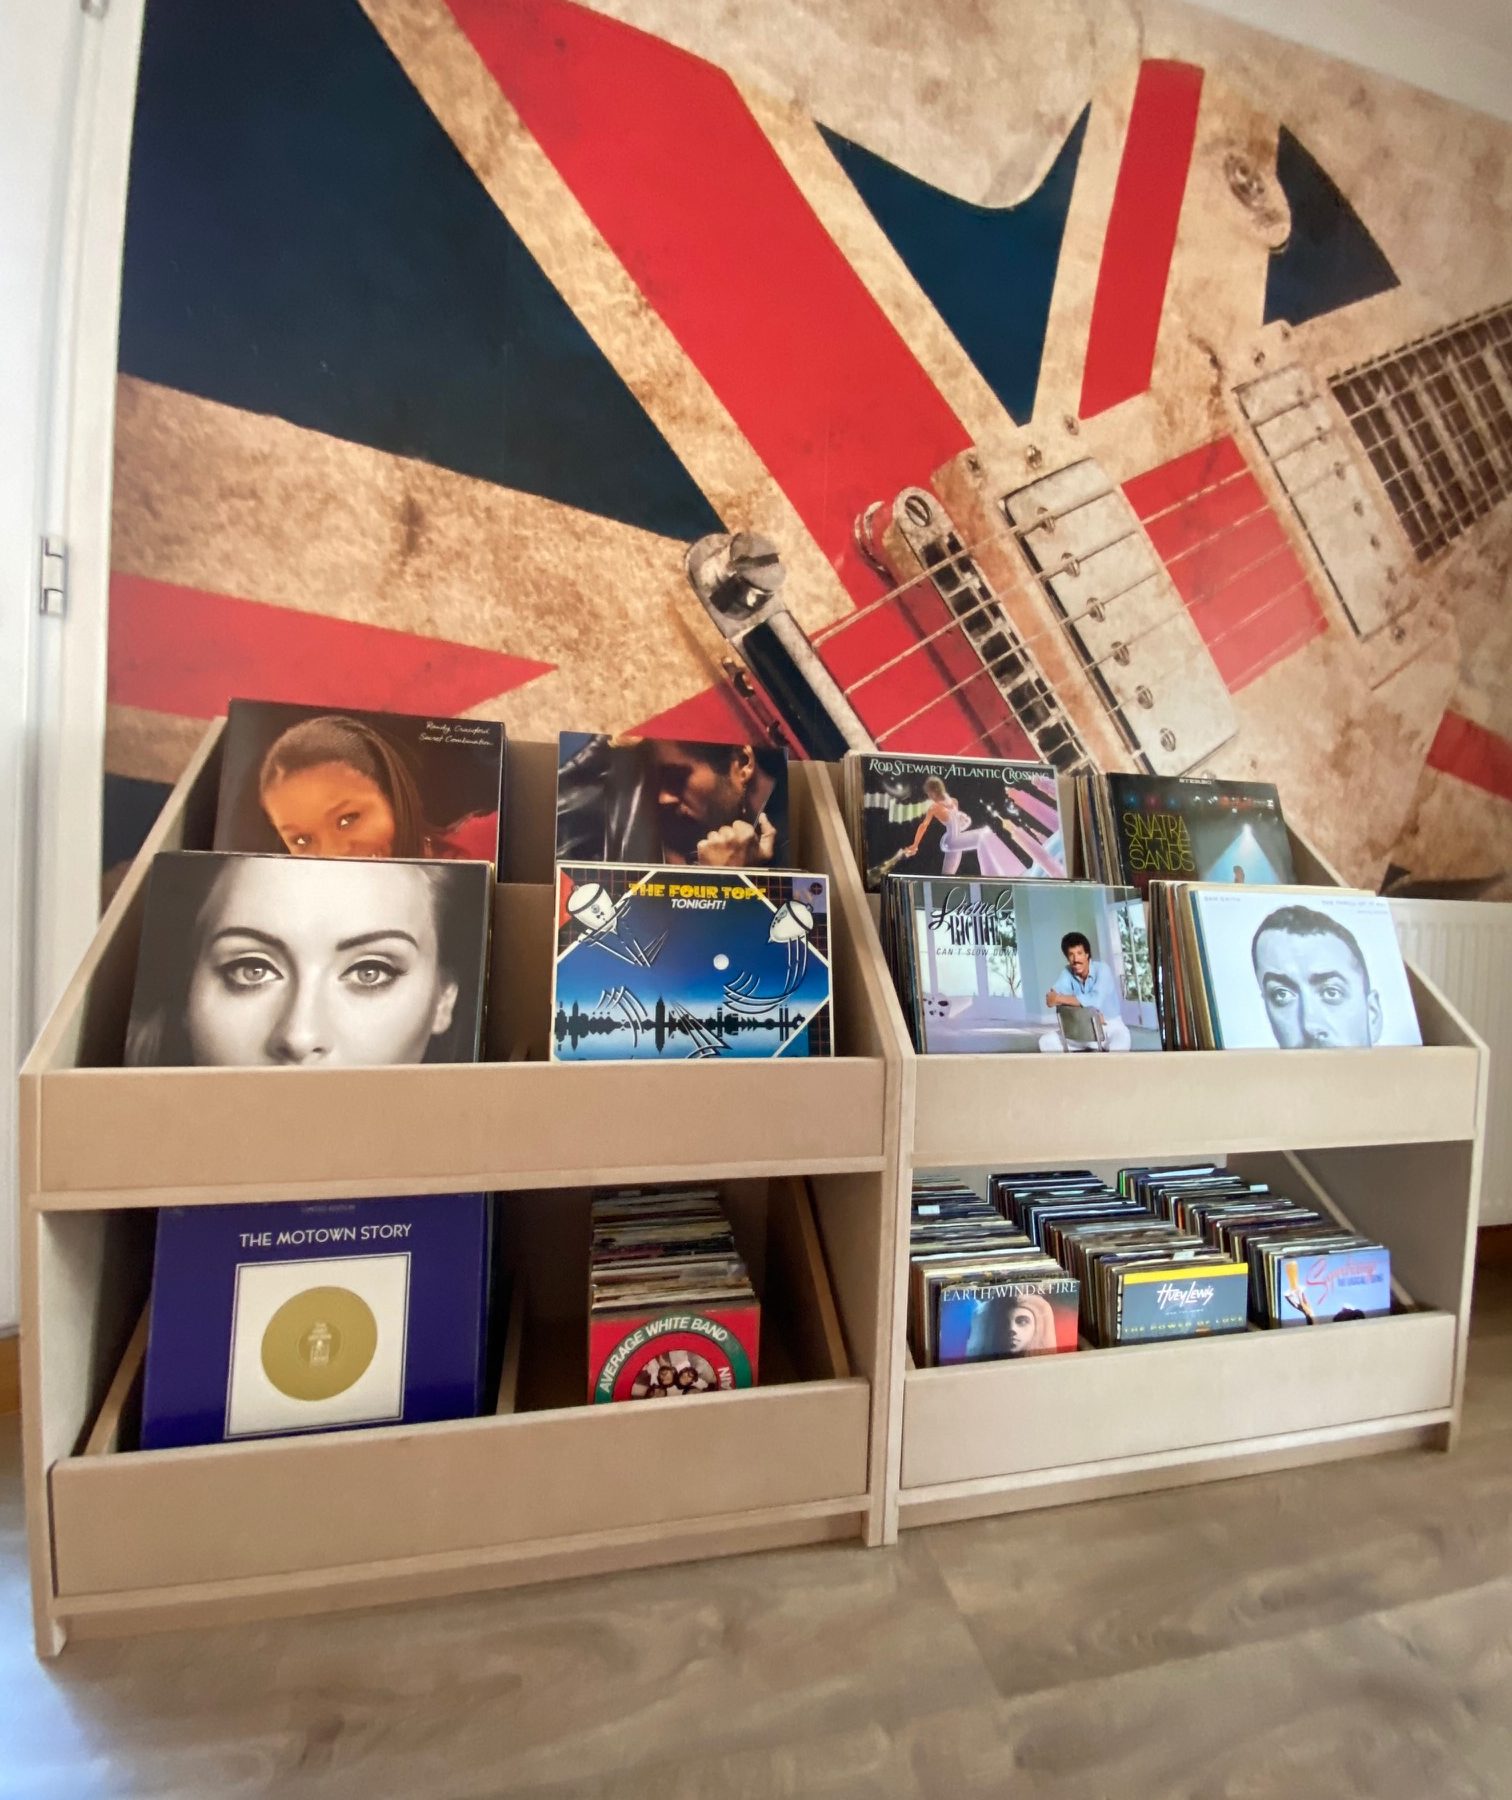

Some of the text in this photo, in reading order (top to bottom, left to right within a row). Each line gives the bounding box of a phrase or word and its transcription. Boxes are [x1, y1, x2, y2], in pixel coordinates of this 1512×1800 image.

[869, 758, 893, 774] ROD
[893, 761, 943, 776] STEWART
[944, 764, 1001, 780] ATLANTIC
[1123, 812, 1190, 838] SINATRA
[1129, 837, 1151, 851] AT
[1129, 848, 1195, 872] SANDS
[628, 883, 767, 900] THE FOUR TOPS
[671, 899, 726, 910] TONIGHT!
[928, 886, 1013, 931] Lionel
[966, 948, 989, 956] SLOW
[240, 1223, 412, 1248] THE MOTOWN STORY
[995, 1284, 1036, 1298] WIND
[1048, 1282, 1078, 1294] FIRE
[600, 1317, 728, 1393] AVERAGE WHITE BAND
